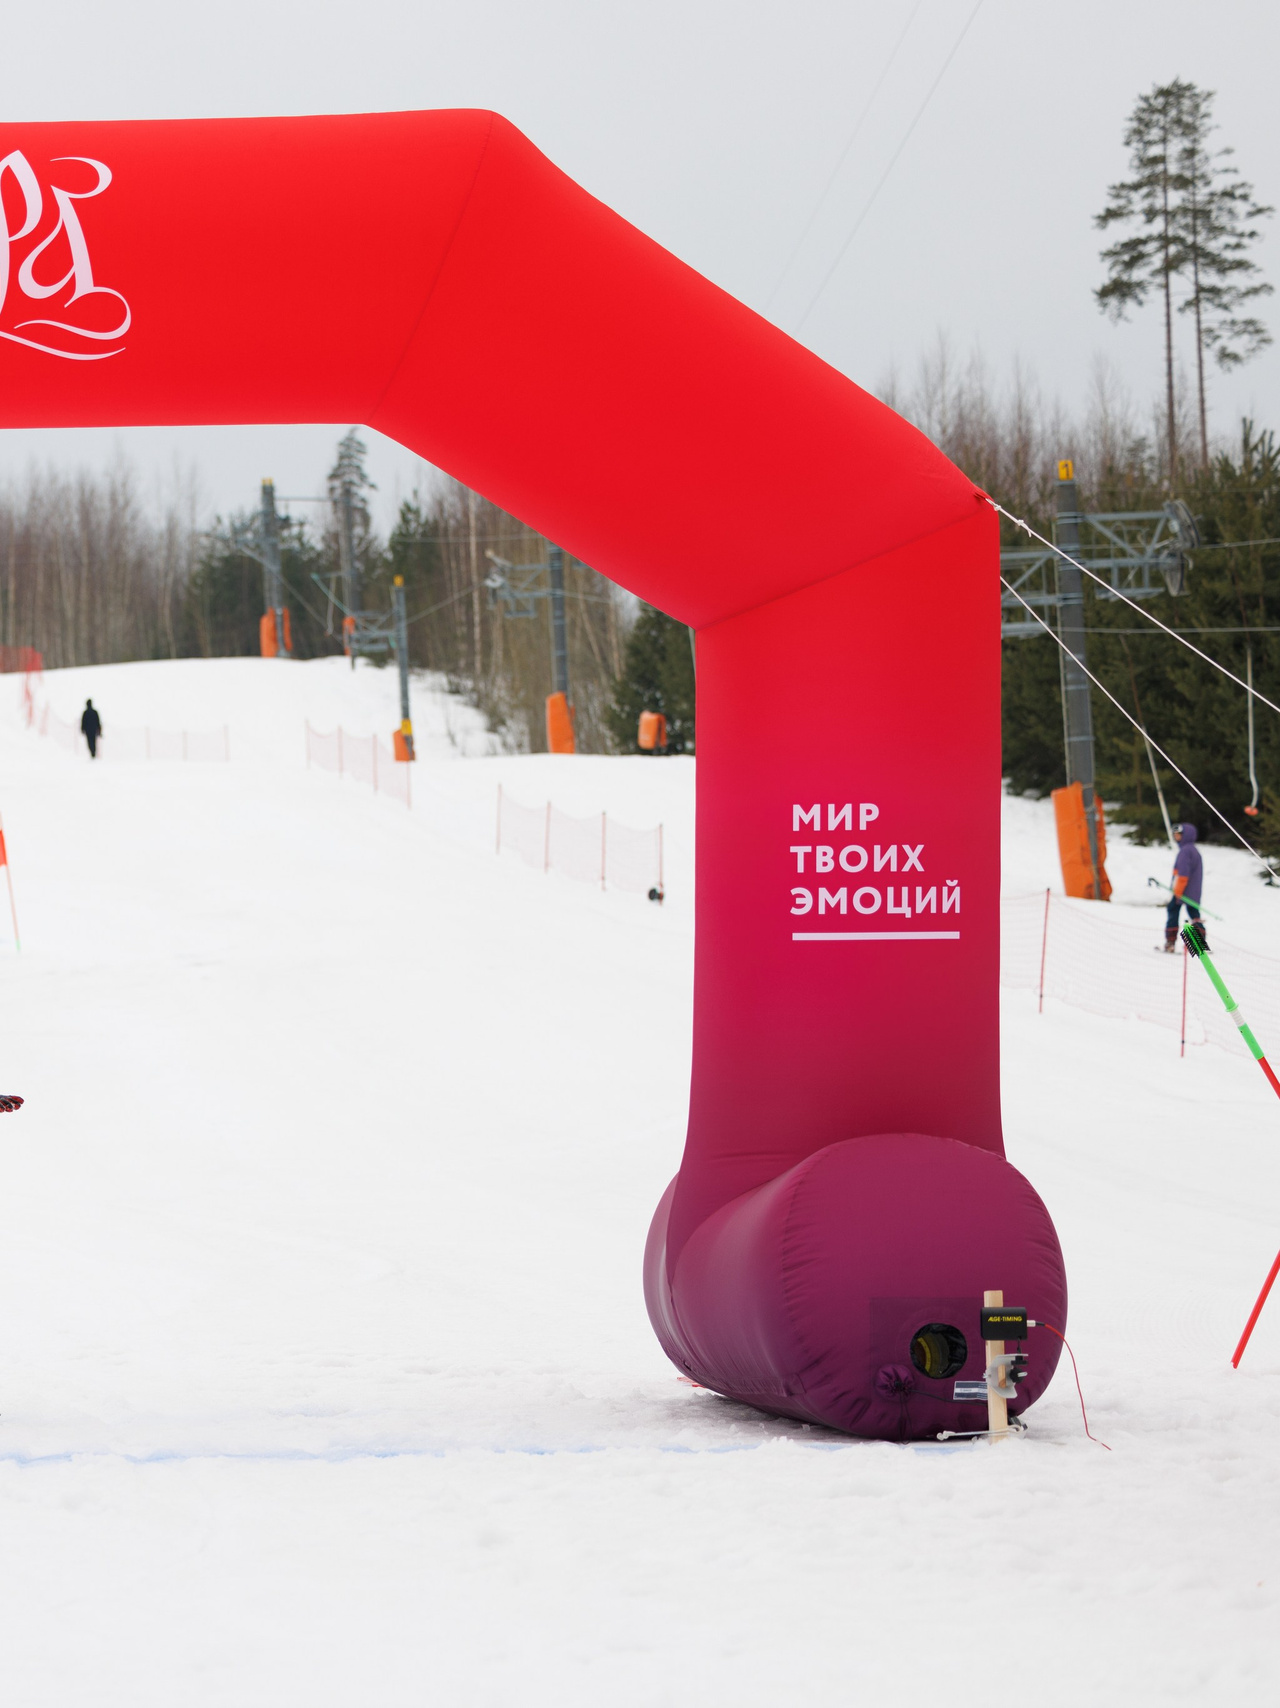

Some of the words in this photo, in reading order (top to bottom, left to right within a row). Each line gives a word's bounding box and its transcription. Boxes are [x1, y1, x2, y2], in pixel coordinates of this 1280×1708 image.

[792, 803, 880, 831] МИР
[789, 844, 925, 873] ТВОИХ
[789, 879, 961, 918] ЭМОЦИЙ
